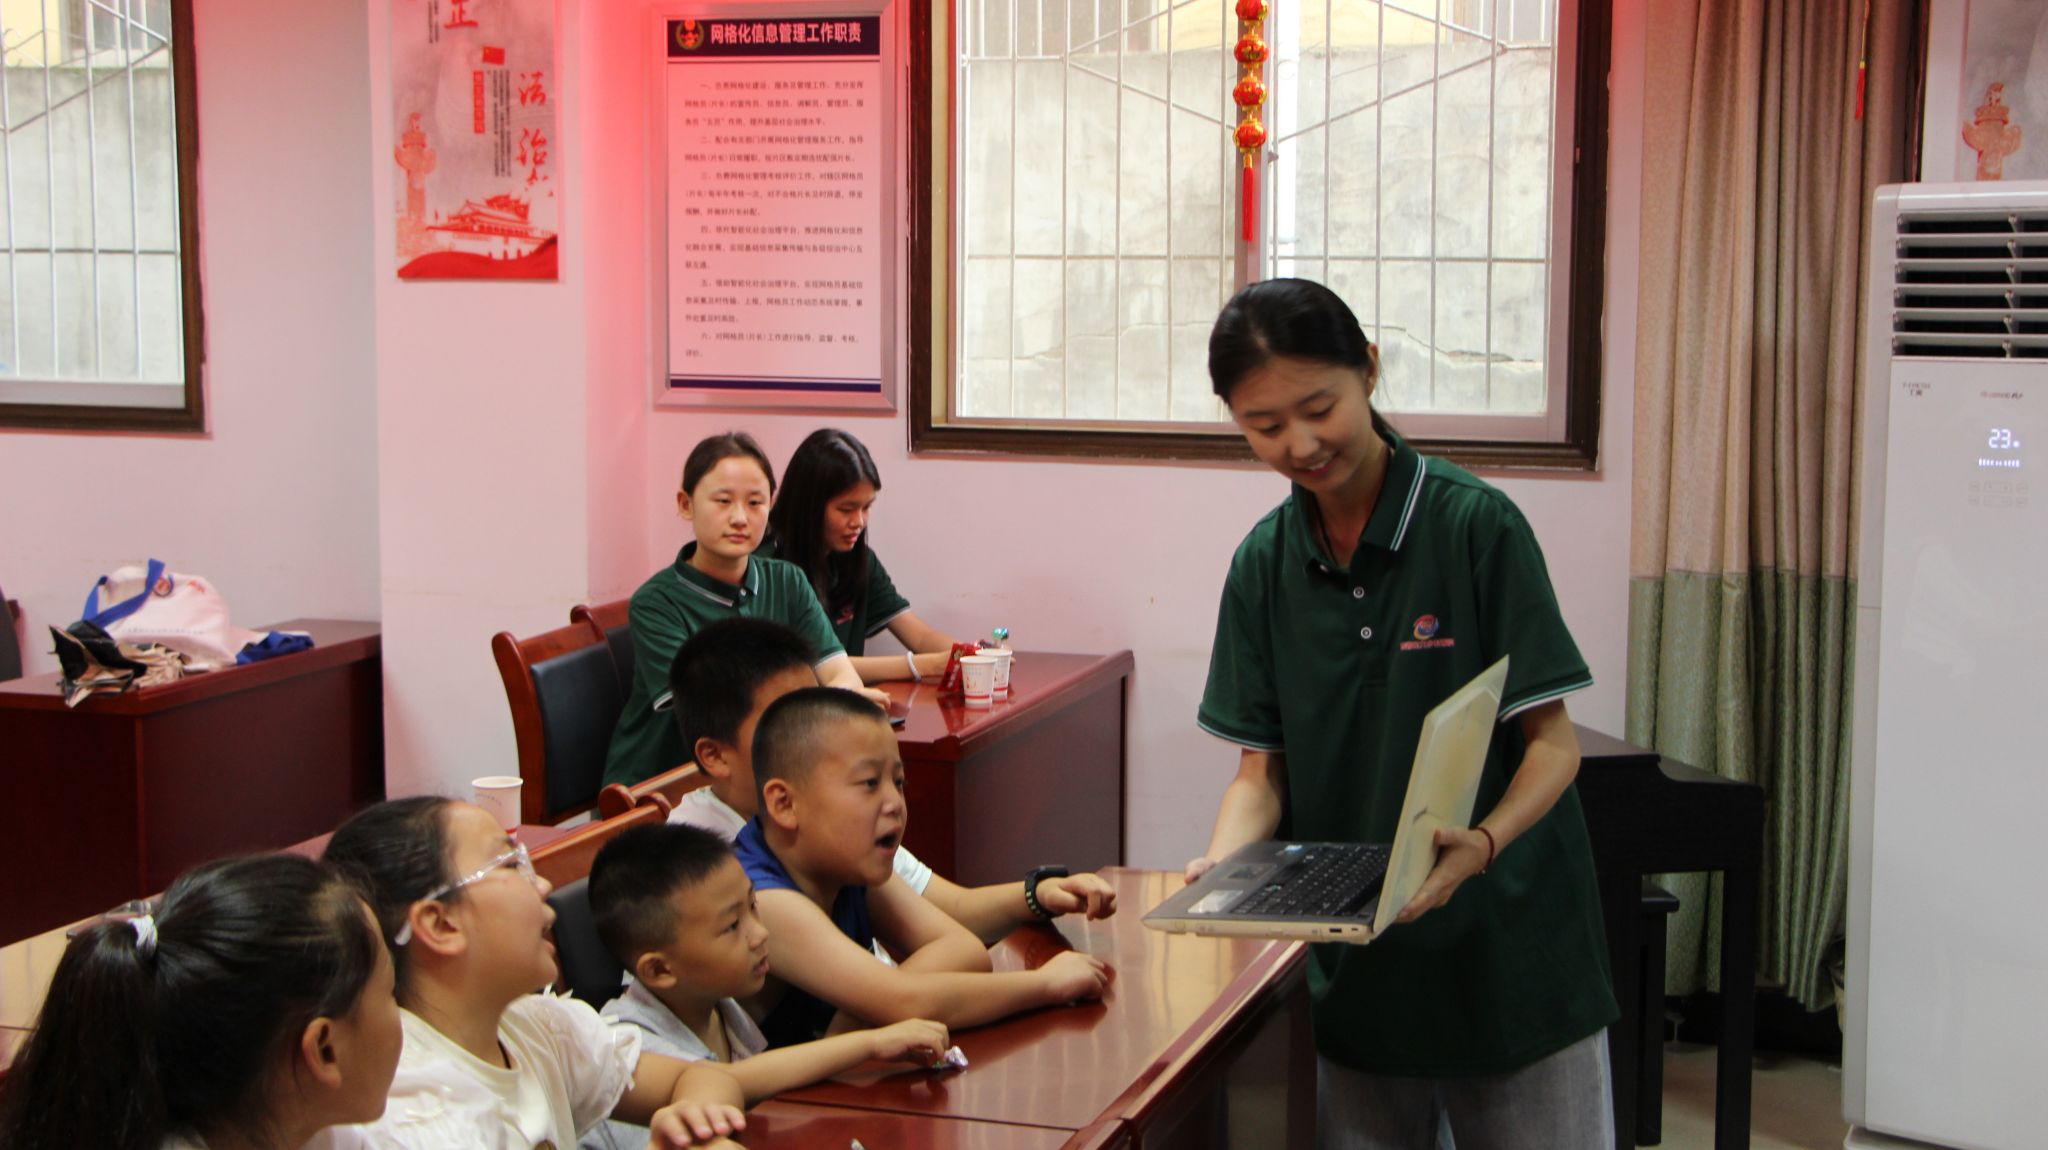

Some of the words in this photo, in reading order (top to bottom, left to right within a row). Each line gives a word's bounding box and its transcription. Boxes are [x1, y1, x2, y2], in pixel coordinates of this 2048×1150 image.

[710, 22, 862, 44] 网格化信息管理工作职责
[517, 71, 549, 167] 法治
[1988, 428, 2012, 449] 23
